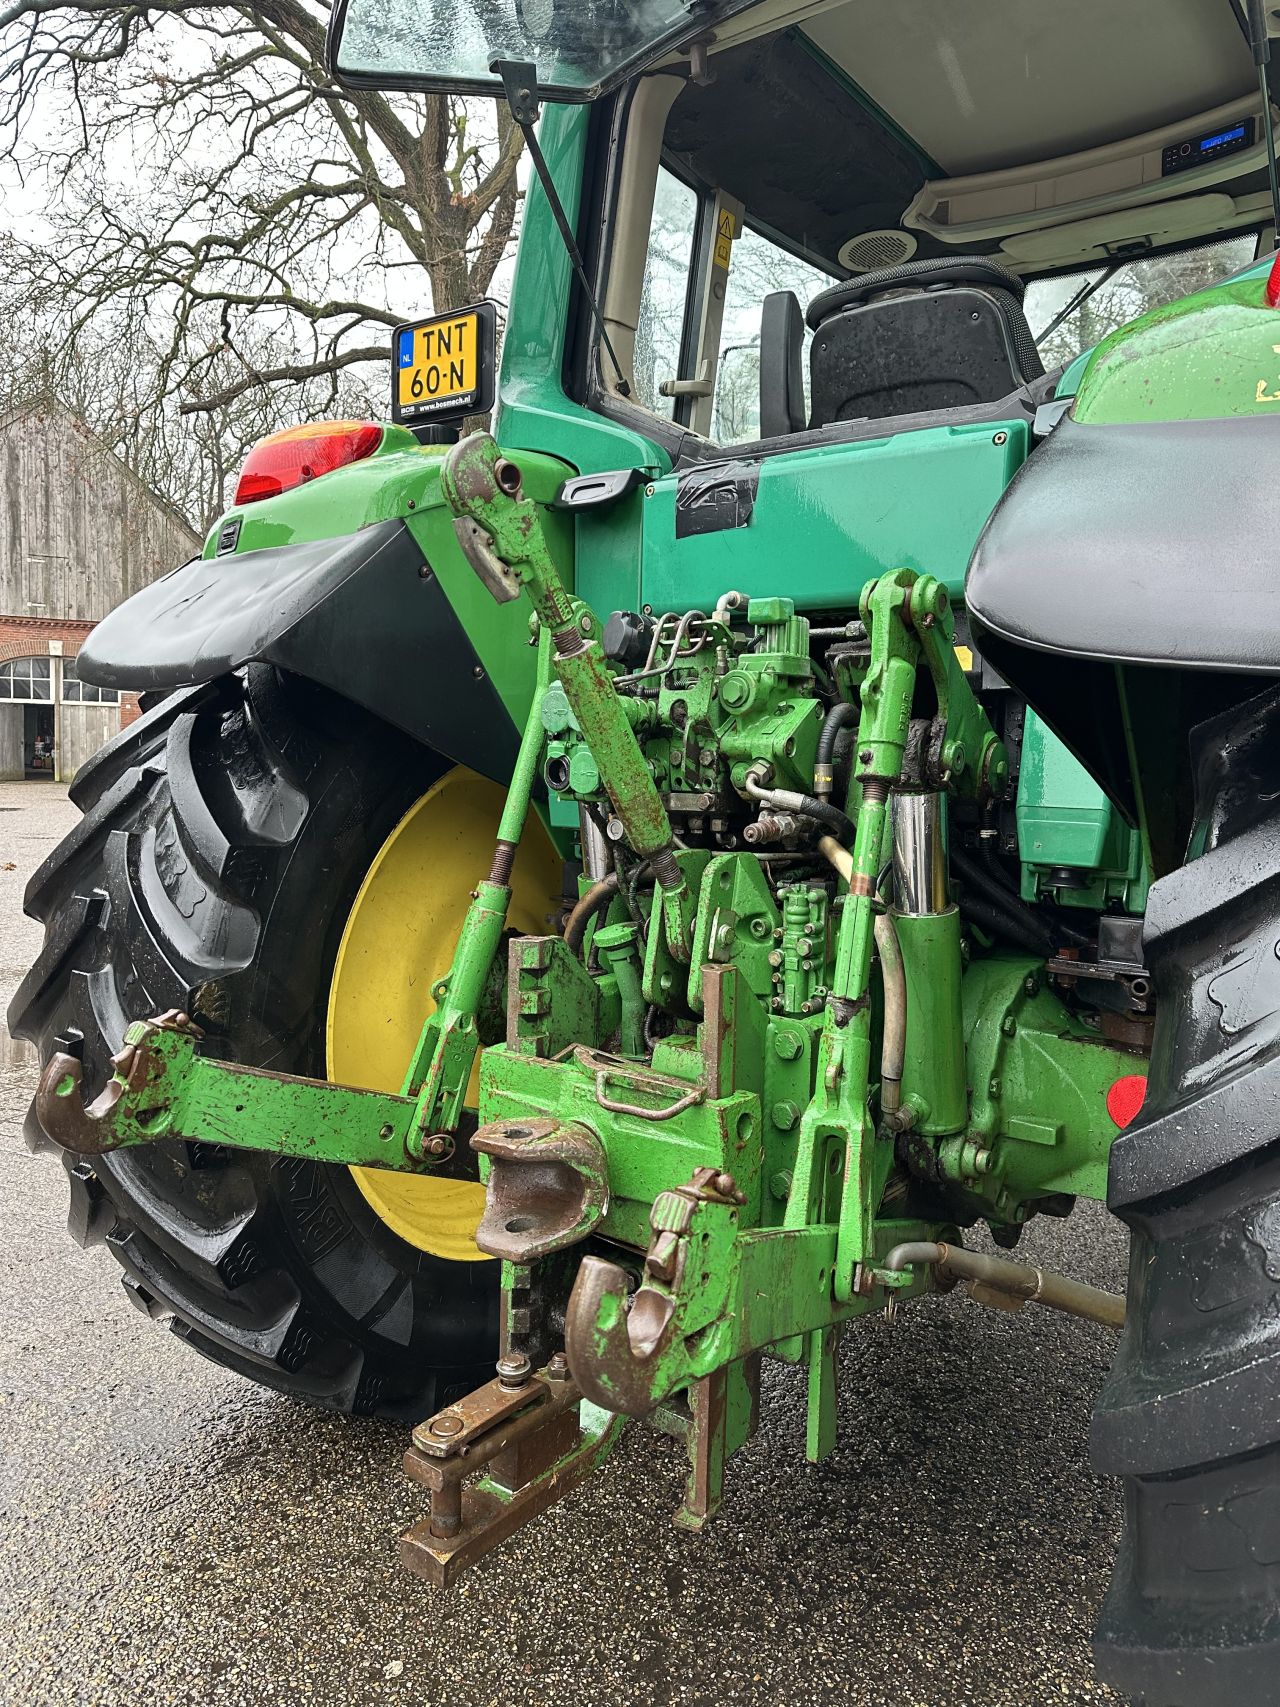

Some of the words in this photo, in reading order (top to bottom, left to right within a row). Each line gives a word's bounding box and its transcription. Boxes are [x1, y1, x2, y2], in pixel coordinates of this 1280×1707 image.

[422, 322, 468, 360] TNT
[402, 353, 411, 363] NL
[411, 358, 464, 398] 60-N
[419, 395, 471, 412] www.bosmech.nl
